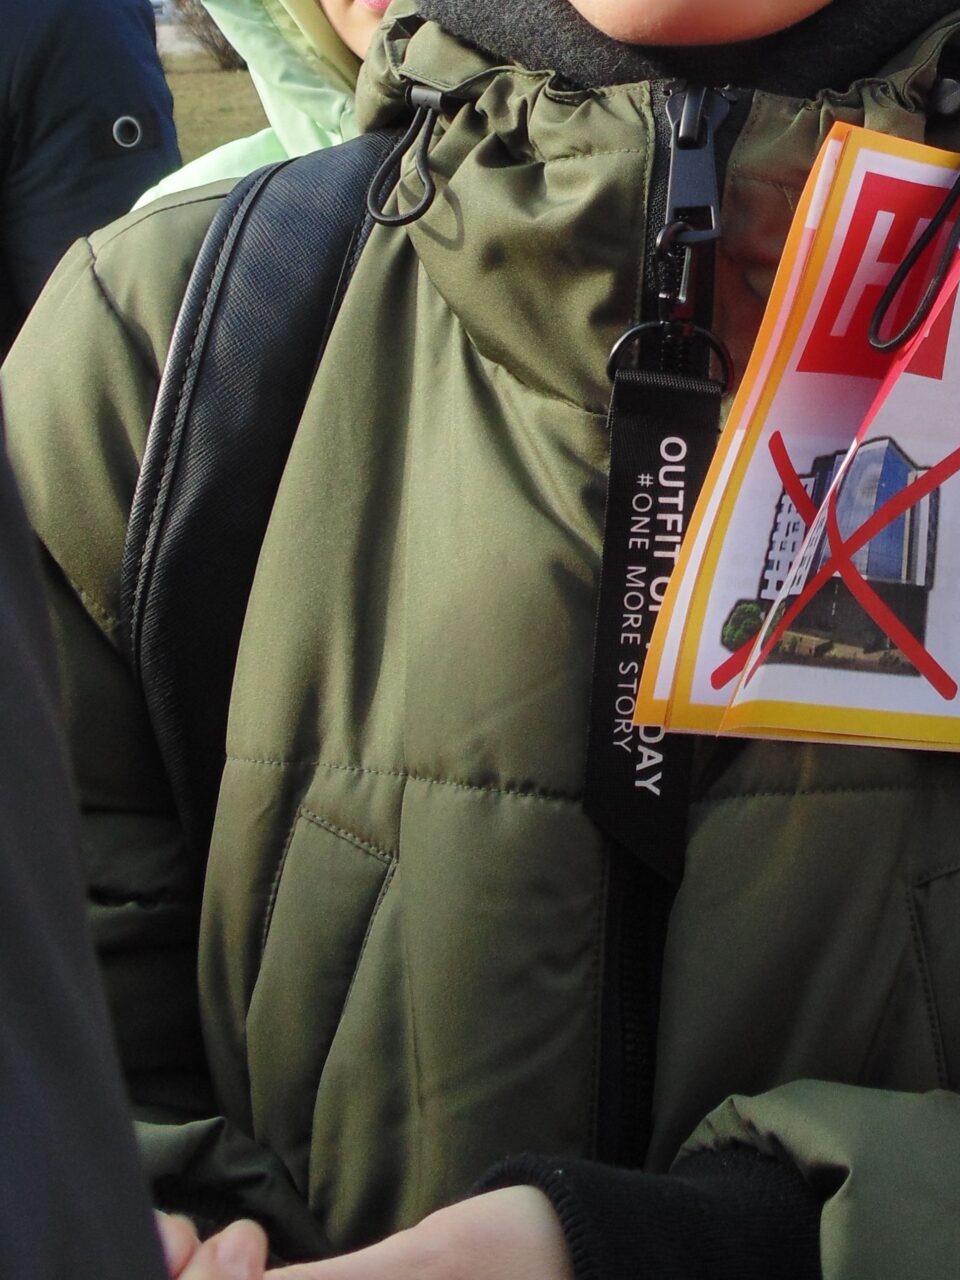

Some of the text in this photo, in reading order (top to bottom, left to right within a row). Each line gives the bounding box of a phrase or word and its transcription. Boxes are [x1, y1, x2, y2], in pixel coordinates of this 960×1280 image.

[653, 436, 688, 566] OUTFIT
[612, 472, 654, 754] #ONE MORE STORY
